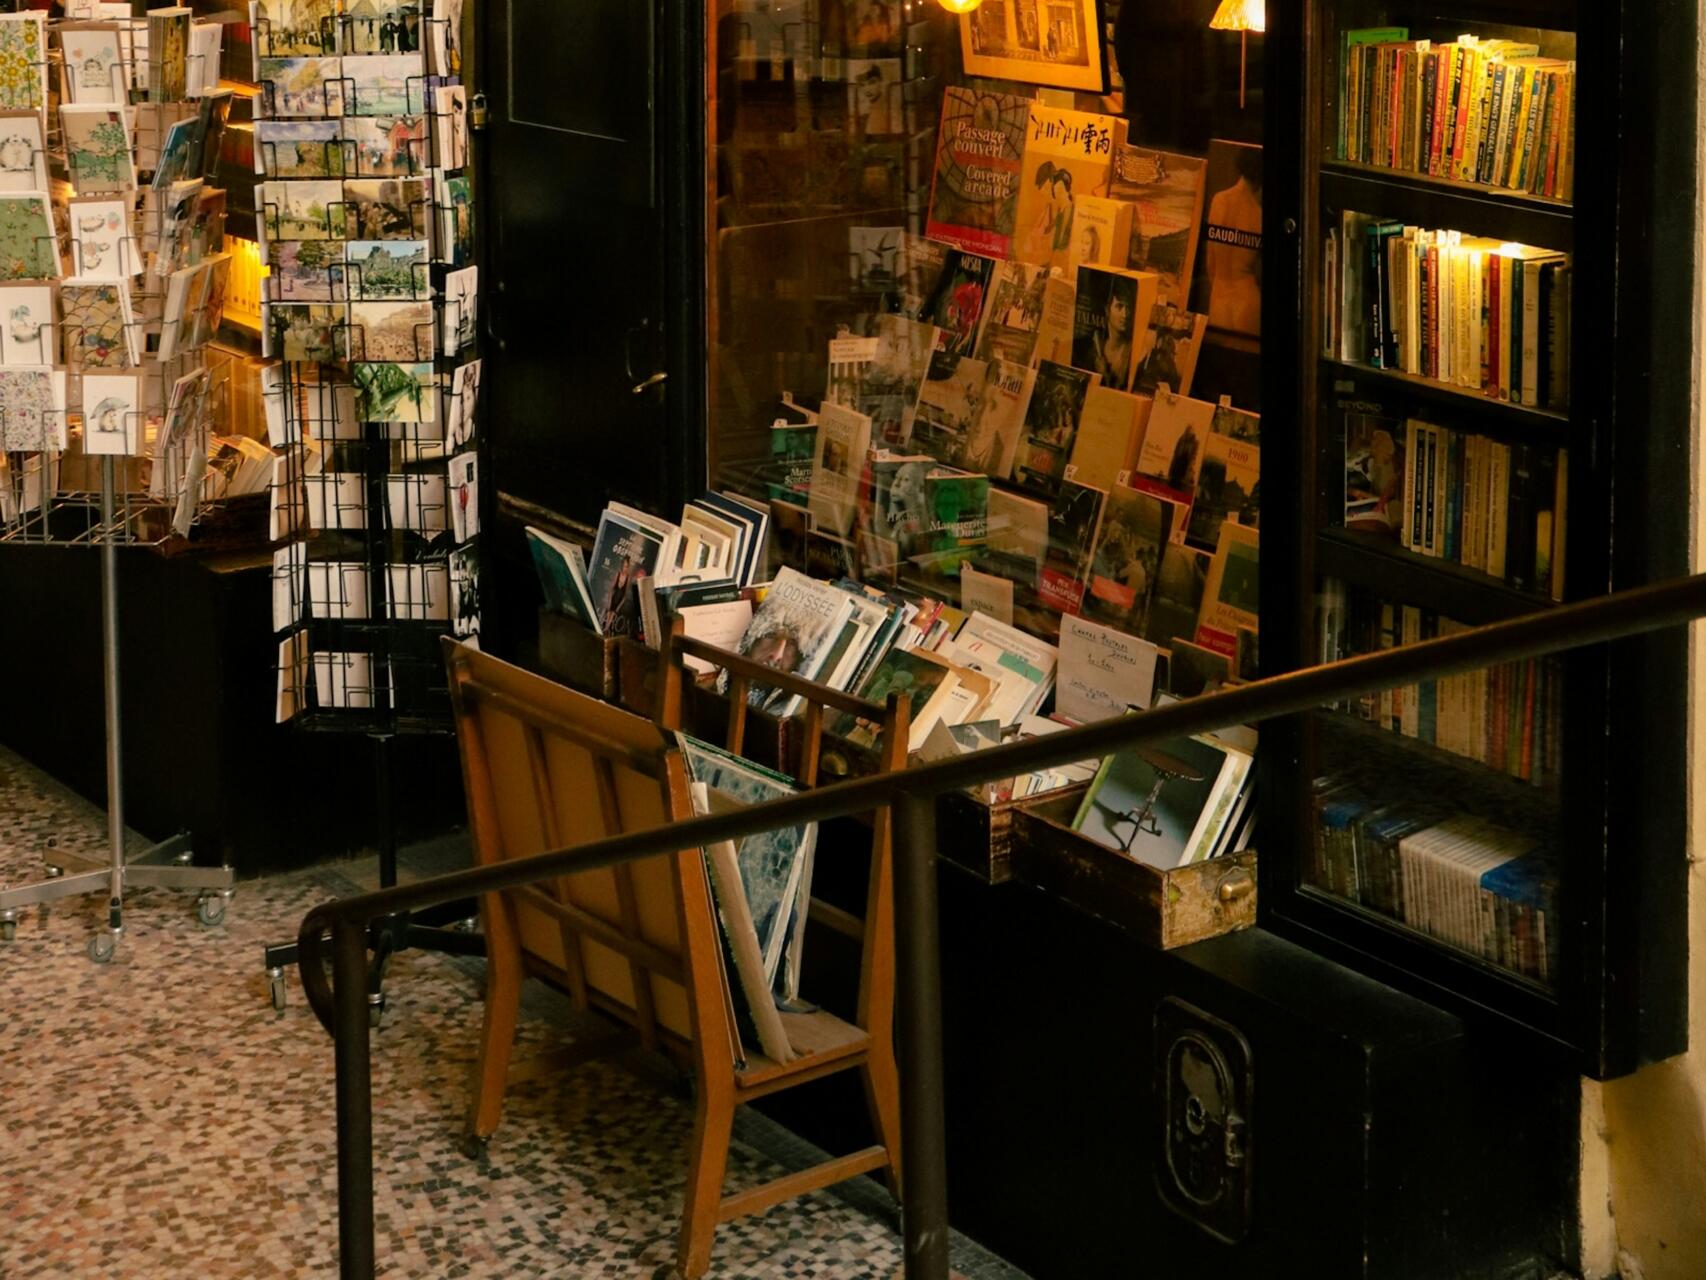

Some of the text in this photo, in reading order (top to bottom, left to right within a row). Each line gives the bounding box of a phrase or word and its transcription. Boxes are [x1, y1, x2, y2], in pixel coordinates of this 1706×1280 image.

[1492, 96, 1500, 119] KING'S
[956, 122, 1006, 144] Passage
[1528, 120, 1534, 130] OF
[1487, 121, 1497, 154] GENERAL
[1525, 132, 1533, 151] GOLD
[954, 138, 1003, 159] couvert
[966, 164, 1011, 185] Covered
[964, 181, 1010, 199] arcade
[1228, 447, 1249, 462] 1900
[929, 519, 985, 532] Marguerite
[776, 581, 835, 617] L'ODYSSÉE
